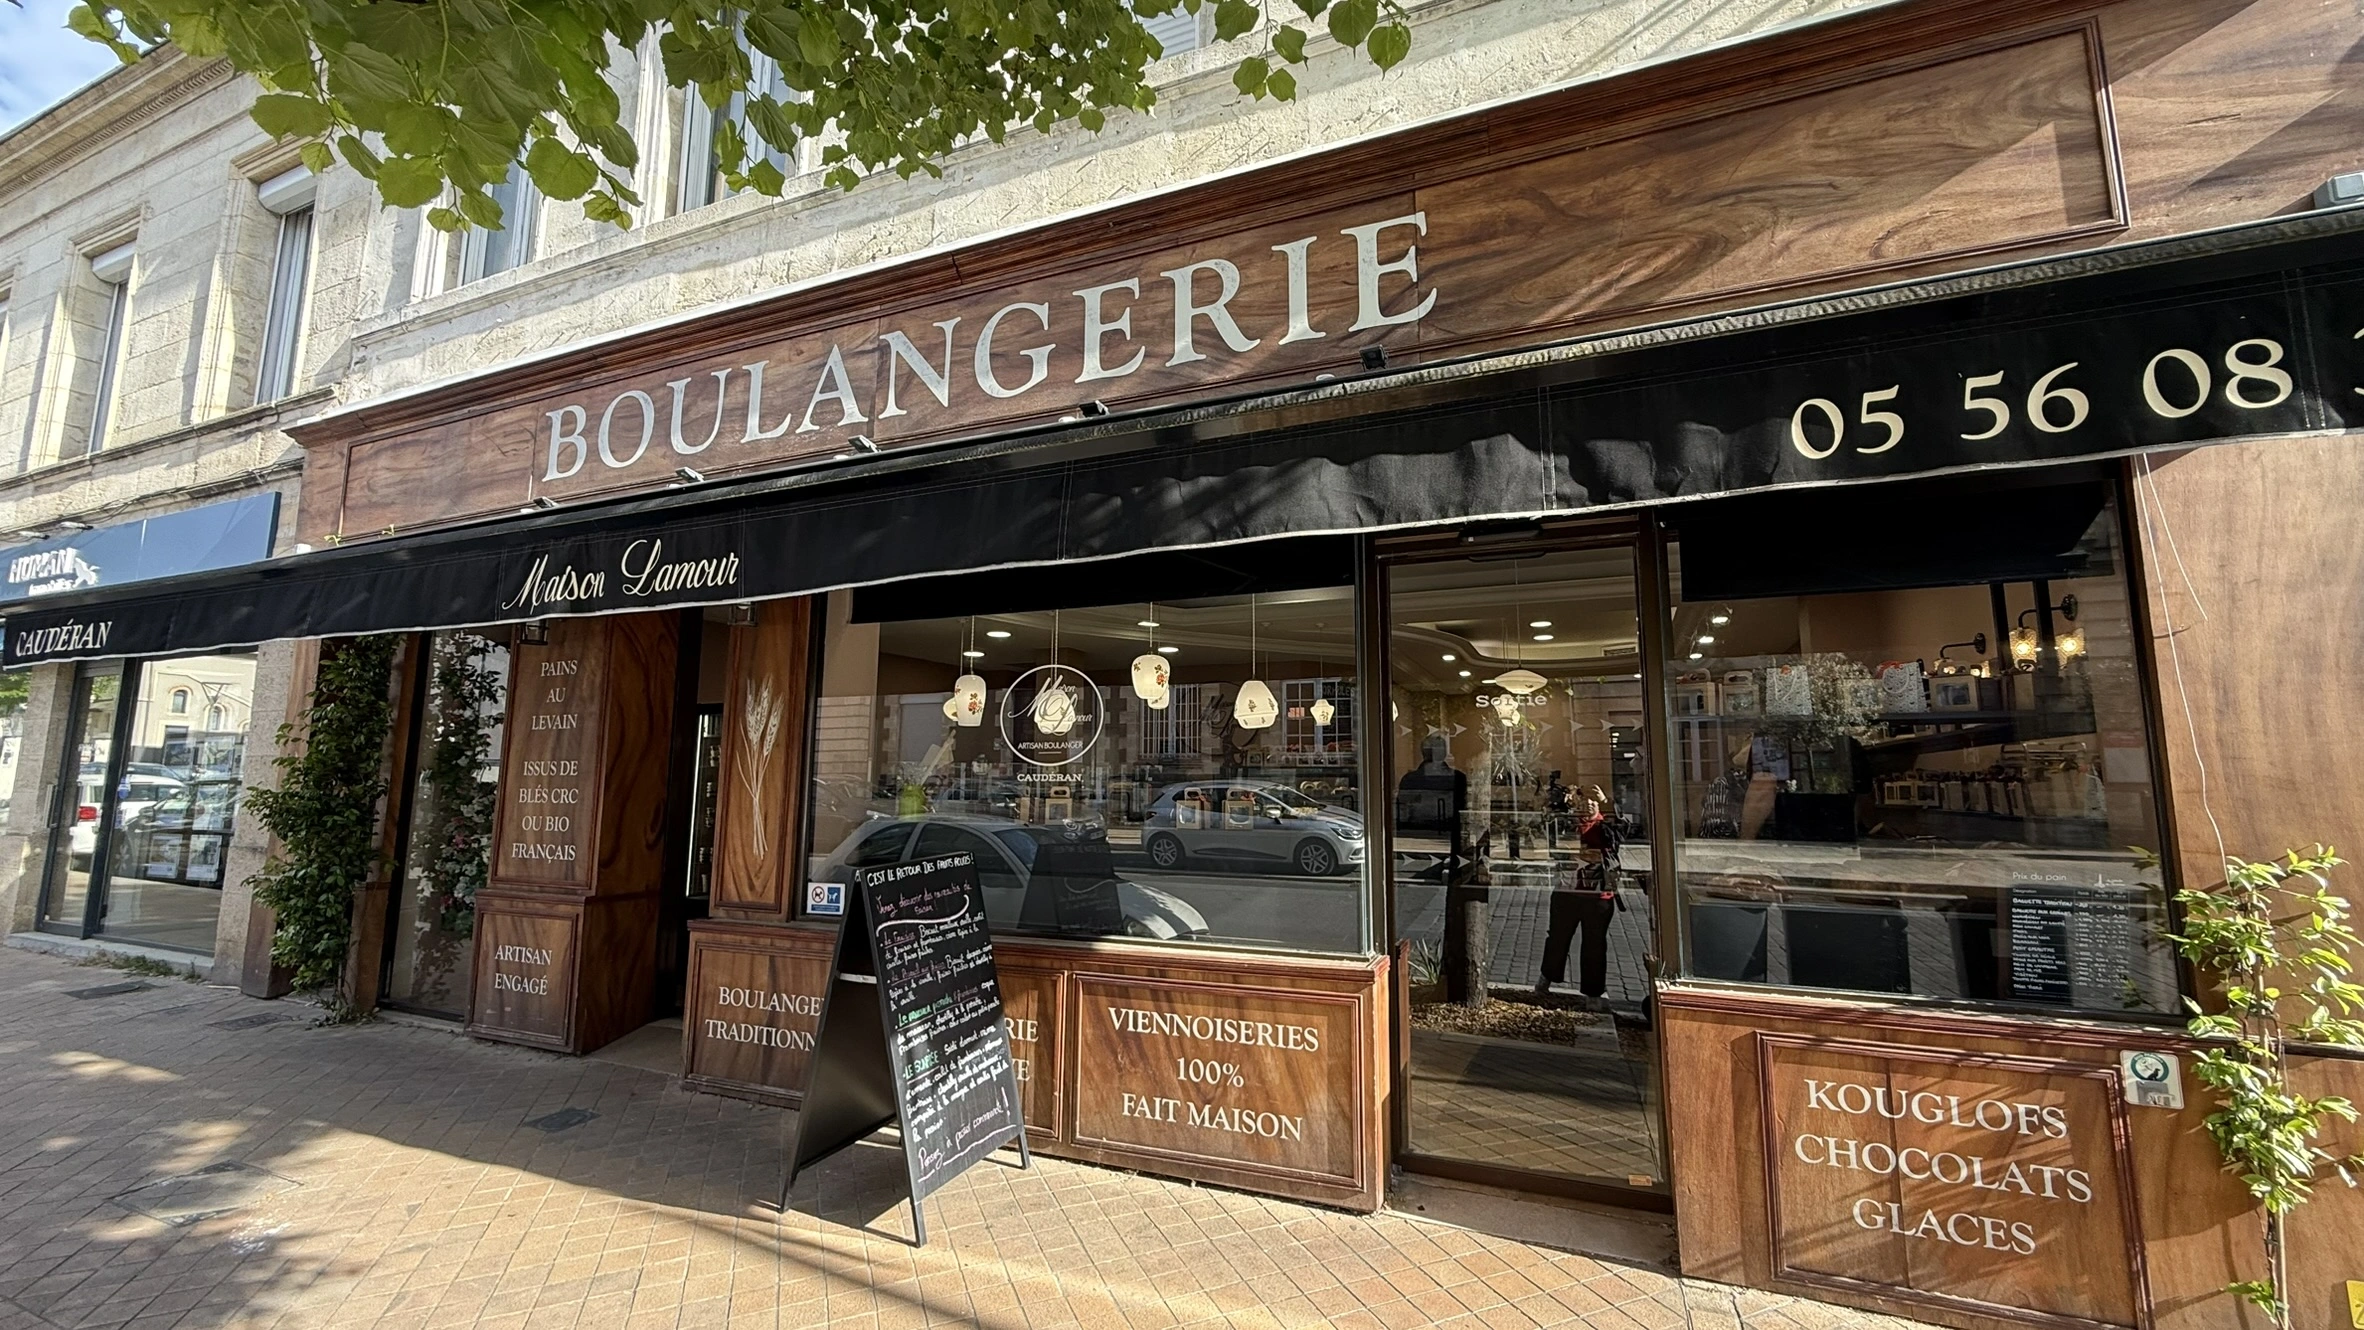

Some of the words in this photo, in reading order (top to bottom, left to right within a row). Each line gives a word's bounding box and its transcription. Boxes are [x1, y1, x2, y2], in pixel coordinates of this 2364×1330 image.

[542, 211, 1438, 482] BOULANGERIE
[1791, 384, 1905, 459] 05
[1961, 362, 2089, 441] 56
[2143, 338, 2293, 418] 08
[502, 554, 605, 614] Maison
[621, 539, 740, 596] Lamour
[16, 618, 112, 656] CAUDÉRAN
[541, 660, 578, 677] PAINS
[547, 688, 566, 703] AU
[1476, 694, 1548, 708] Sortie
[531, 714, 578, 730] LEVAIN
[1018, 742, 1044, 750] ARTISAN
[1044, 741, 1083, 749] BOULANGER
[524, 760, 557, 776] ISSUS
[560, 760, 578, 776] DE
[1017, 772, 1082, 782] CAUDÉRAN
[519, 785, 548, 804] BLÉS
[551, 788, 578, 804] CRC
[522, 816, 542, 831] OU
[545, 817, 569, 832] BIO
[512, 843, 576, 863] FRANÇAIS
[887, 869, 895, 881] LE
[896, 864, 922, 880] RETOUR
[922, 861, 935, 874] DES
[2012, 872, 2028, 881] Prix
[2030, 873, 2042, 881] du
[2045, 874, 2067, 882] pain
[495, 945, 552, 965] ARTISAN
[494, 973, 548, 996] ENGAGÉ
[718, 986, 825, 1016] BOULANGE
[1108, 1007, 1319, 1052] VIENNOISERIES
[1177, 1057, 1245, 1088] 100%
[1122, 1093, 1181, 1122] FAIT
[1187, 1102, 1303, 1141] MAISON
[1803, 1079, 2068, 1139] KOUGLOFS
[1795, 1134, 2092, 1203] CHOCOLATS
[1853, 1198, 2036, 1255] GLACES
